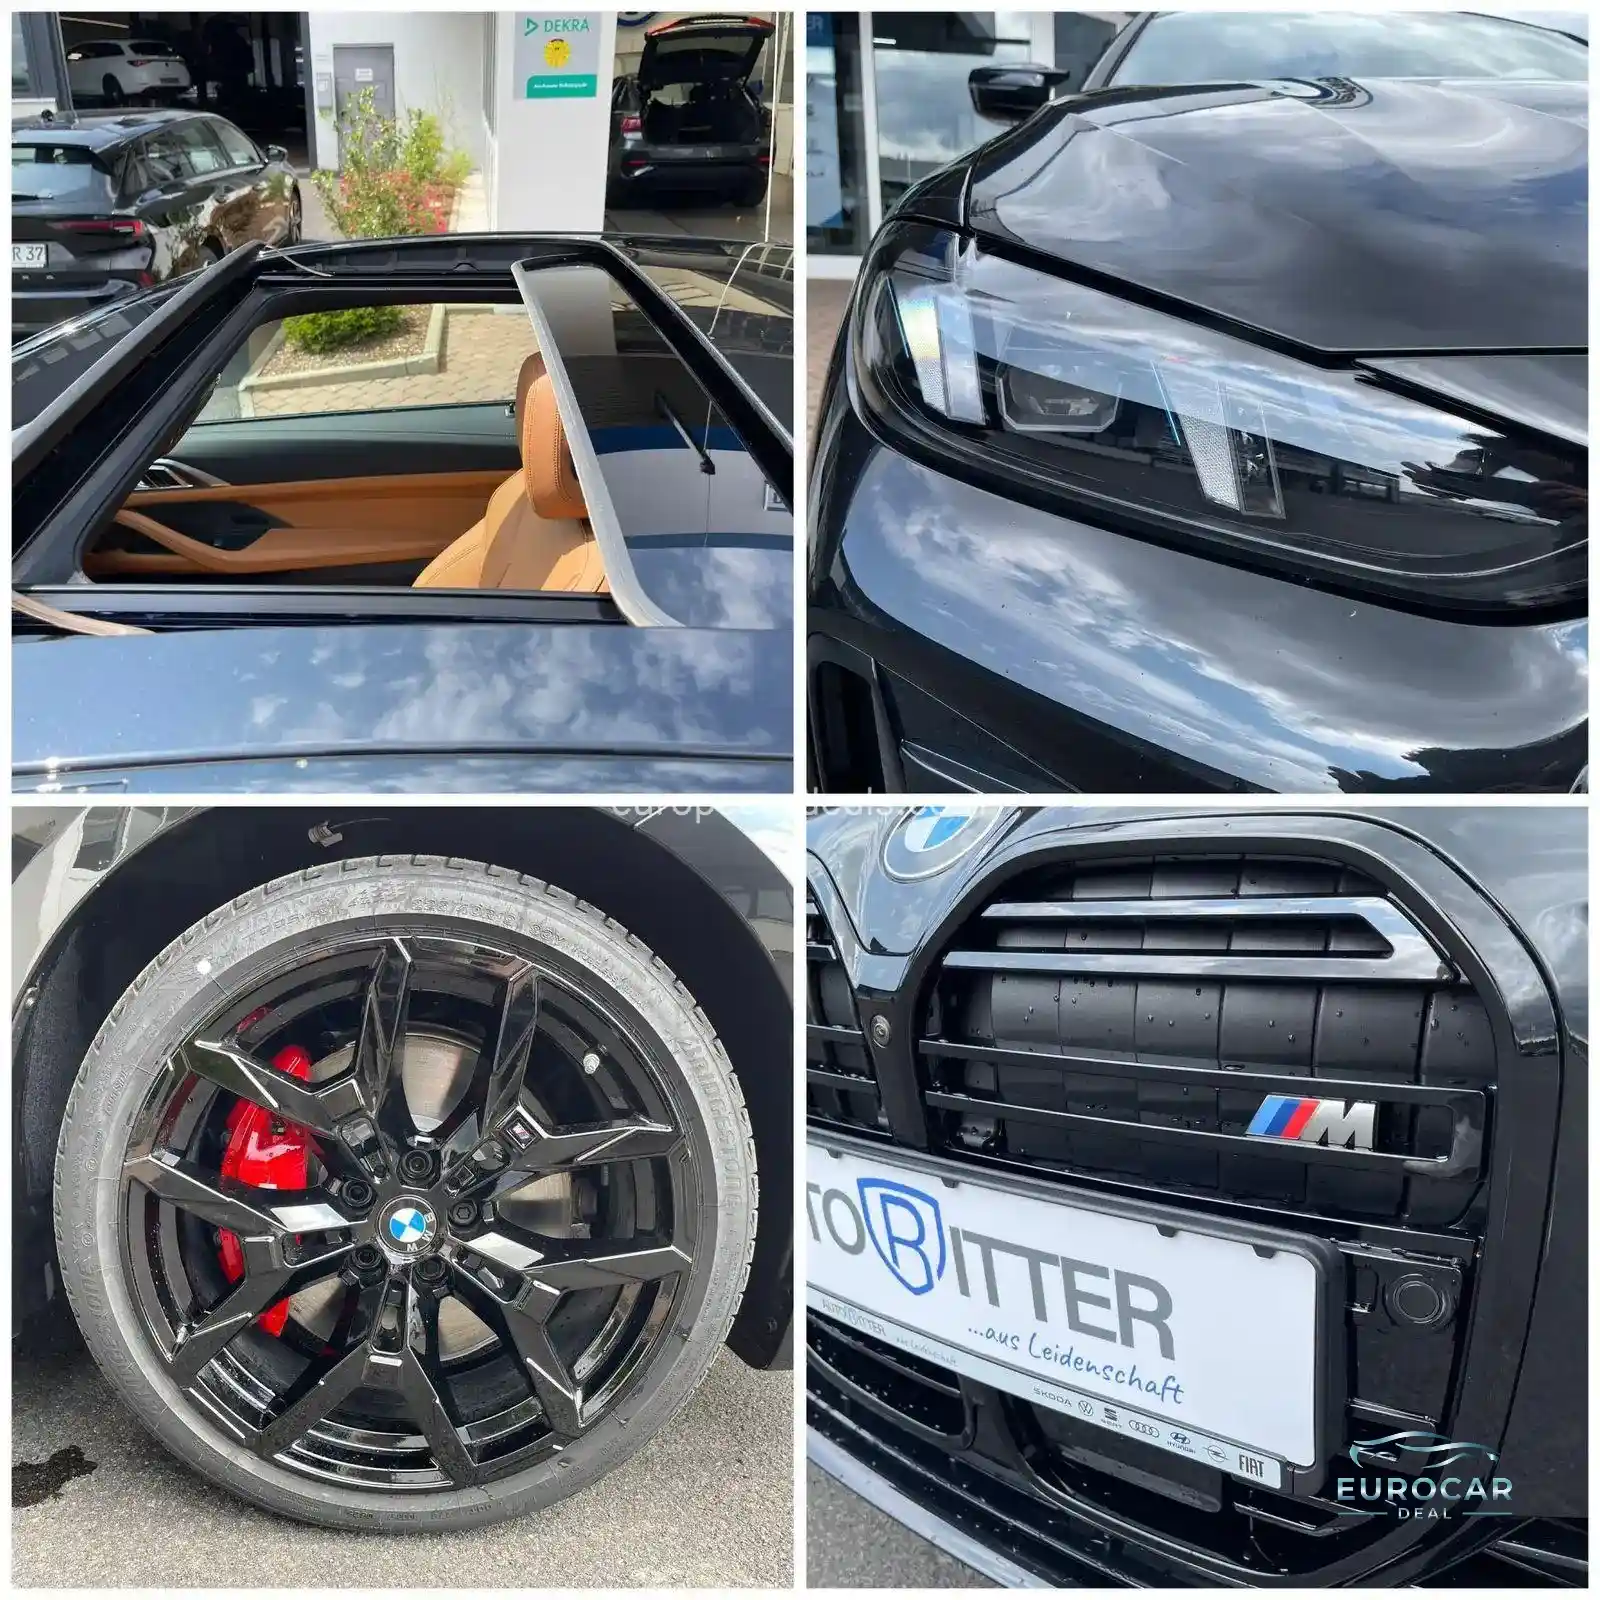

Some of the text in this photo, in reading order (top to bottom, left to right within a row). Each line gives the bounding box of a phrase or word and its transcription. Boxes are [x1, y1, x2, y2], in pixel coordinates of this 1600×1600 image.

[544, 18, 590, 33] DEKRA
[26, 246, 43, 261] 37
[1028, 1332, 1185, 1404] Leidenschaft
[1239, 1453, 1265, 1478] FIAT
